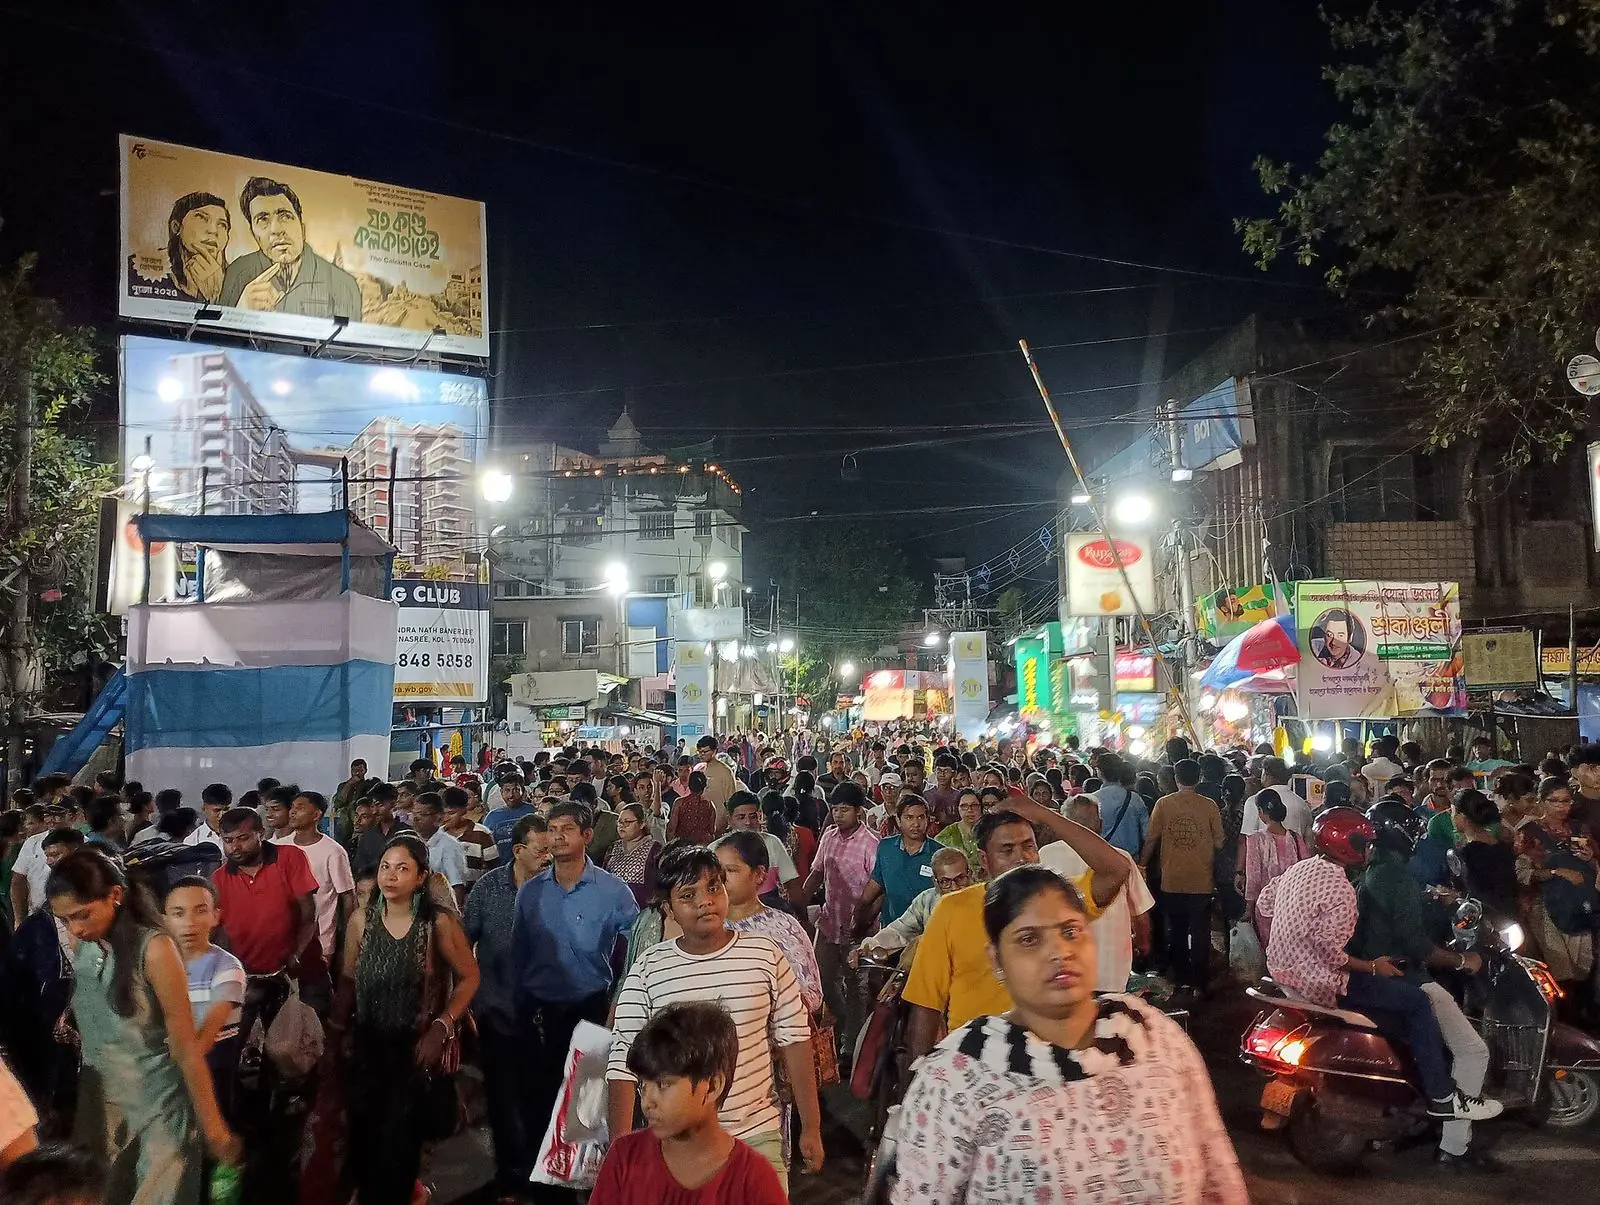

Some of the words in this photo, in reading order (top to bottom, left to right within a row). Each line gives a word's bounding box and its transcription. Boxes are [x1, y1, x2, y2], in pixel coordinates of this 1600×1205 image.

[384, 257, 412, 267] Calcutta
[413, 261, 431, 269] Case
[413, 586, 461, 604] CLUB
[439, 628, 474, 636] BANERJEE
[398, 653, 431, 668] 848
[437, 653, 473, 668] 5858
